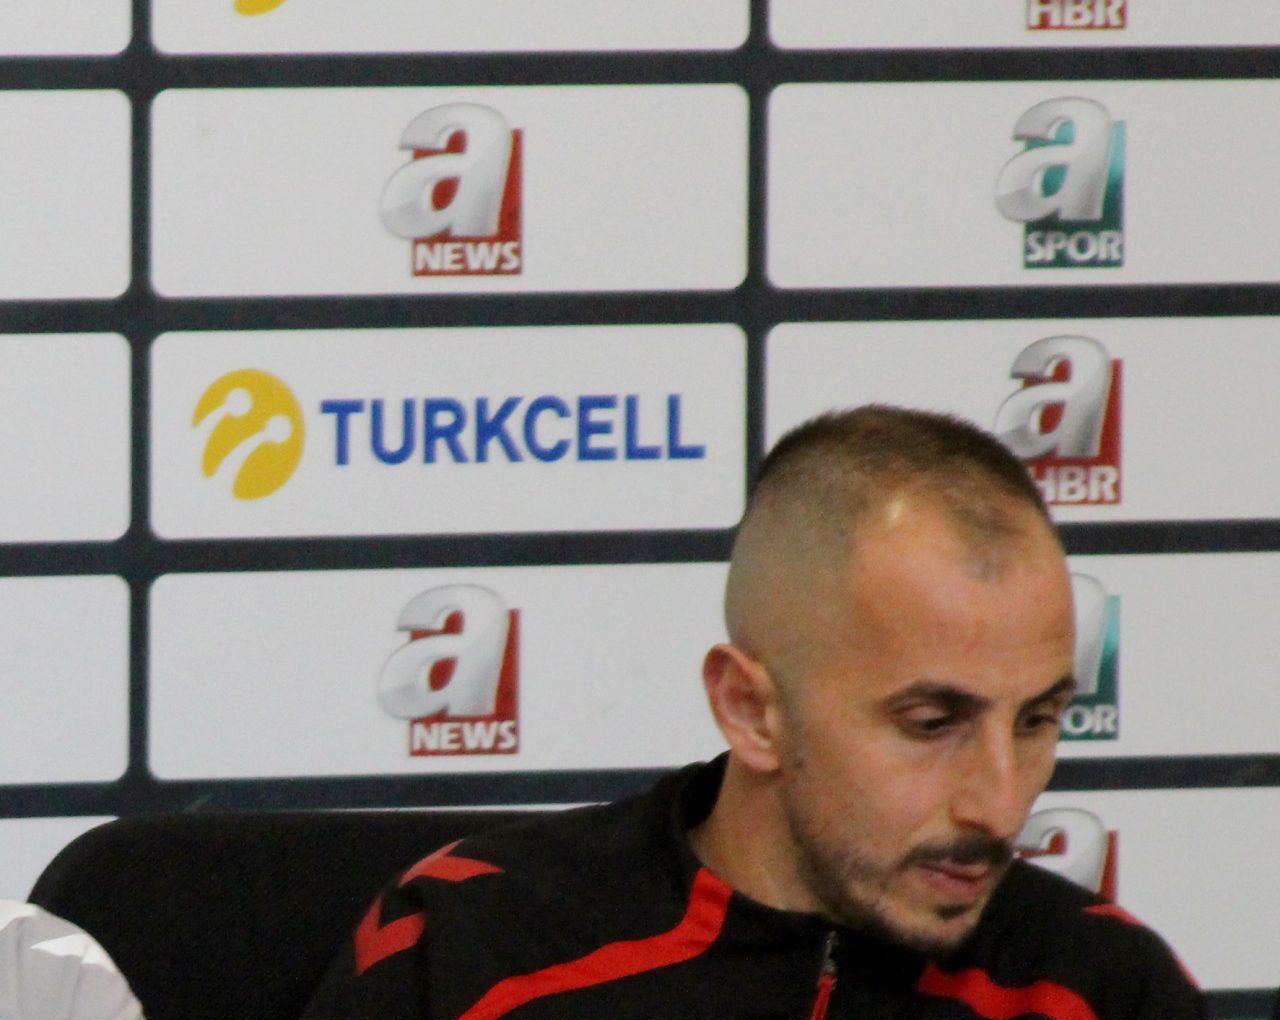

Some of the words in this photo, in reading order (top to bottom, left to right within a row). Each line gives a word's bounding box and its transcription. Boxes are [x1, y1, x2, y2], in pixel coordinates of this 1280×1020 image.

[1027, 0, 1124, 28] HBR
[415, 242, 519, 271] NEWS
[1024, 231, 1122, 262] SPOR
[321, 394, 707, 466] TURKCELL
[1061, 704, 1117, 734] OR
[412, 720, 517, 752] NEWS
